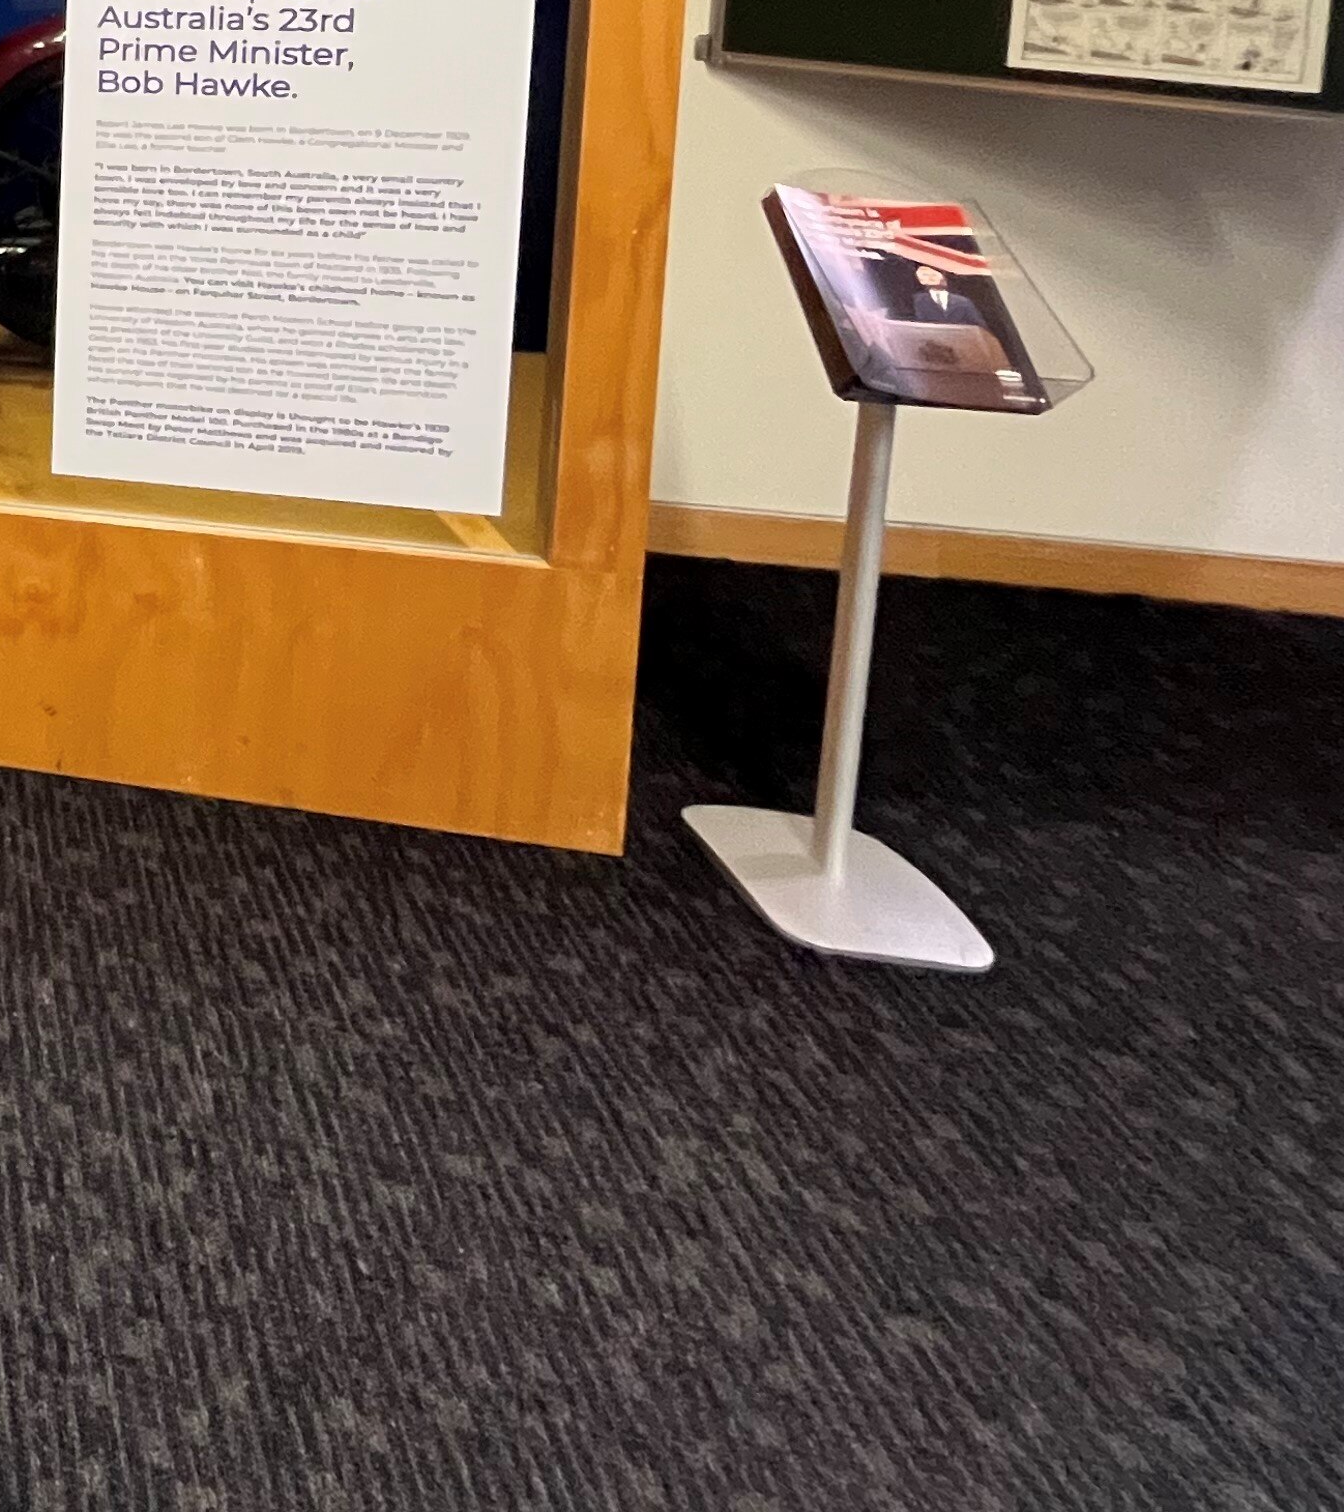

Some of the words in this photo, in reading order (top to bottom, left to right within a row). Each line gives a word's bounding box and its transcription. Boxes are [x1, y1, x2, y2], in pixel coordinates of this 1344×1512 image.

[96, 5, 270, 31] Australia's
[278, 8, 355, 33] 23rd
[99, 37, 198, 63] Prime
[209, 39, 354, 71] Minister,
[97, 69, 164, 95] Bob
[175, 71, 299, 99] Hawke.
